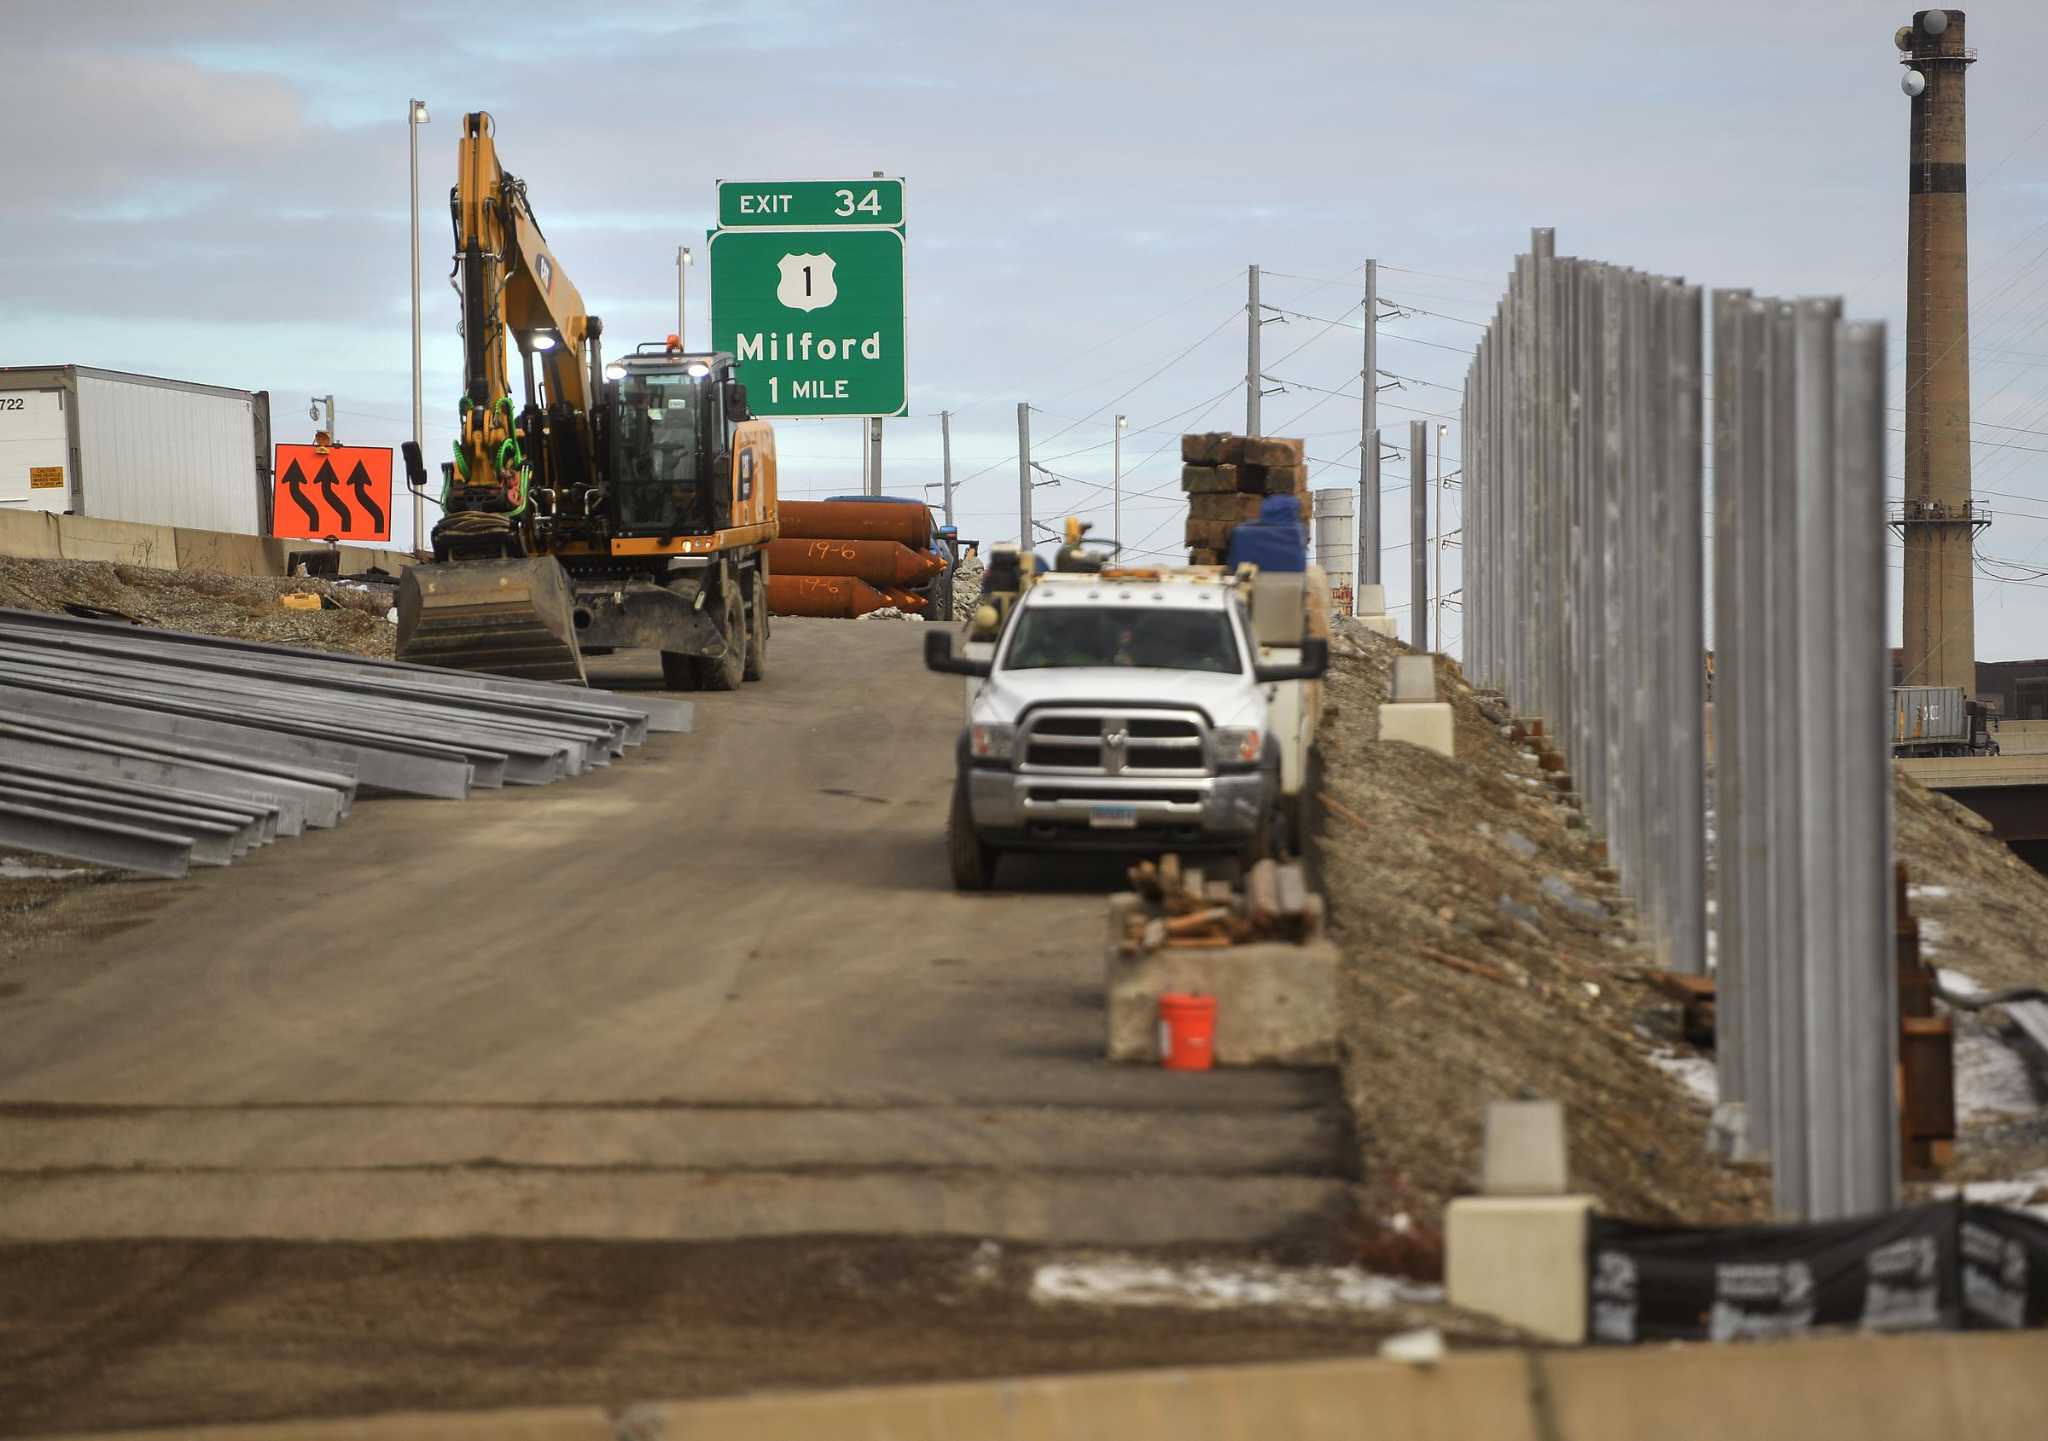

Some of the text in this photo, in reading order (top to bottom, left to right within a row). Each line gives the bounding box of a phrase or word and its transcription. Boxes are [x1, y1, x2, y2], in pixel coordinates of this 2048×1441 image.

[740, 189, 882, 217] EXIT 34
[802, 265, 812, 297] 1
[736, 331, 881, 361] Milford
[768, 376, 849, 404] 1 MILE
[0, 398, 25, 411] 722
